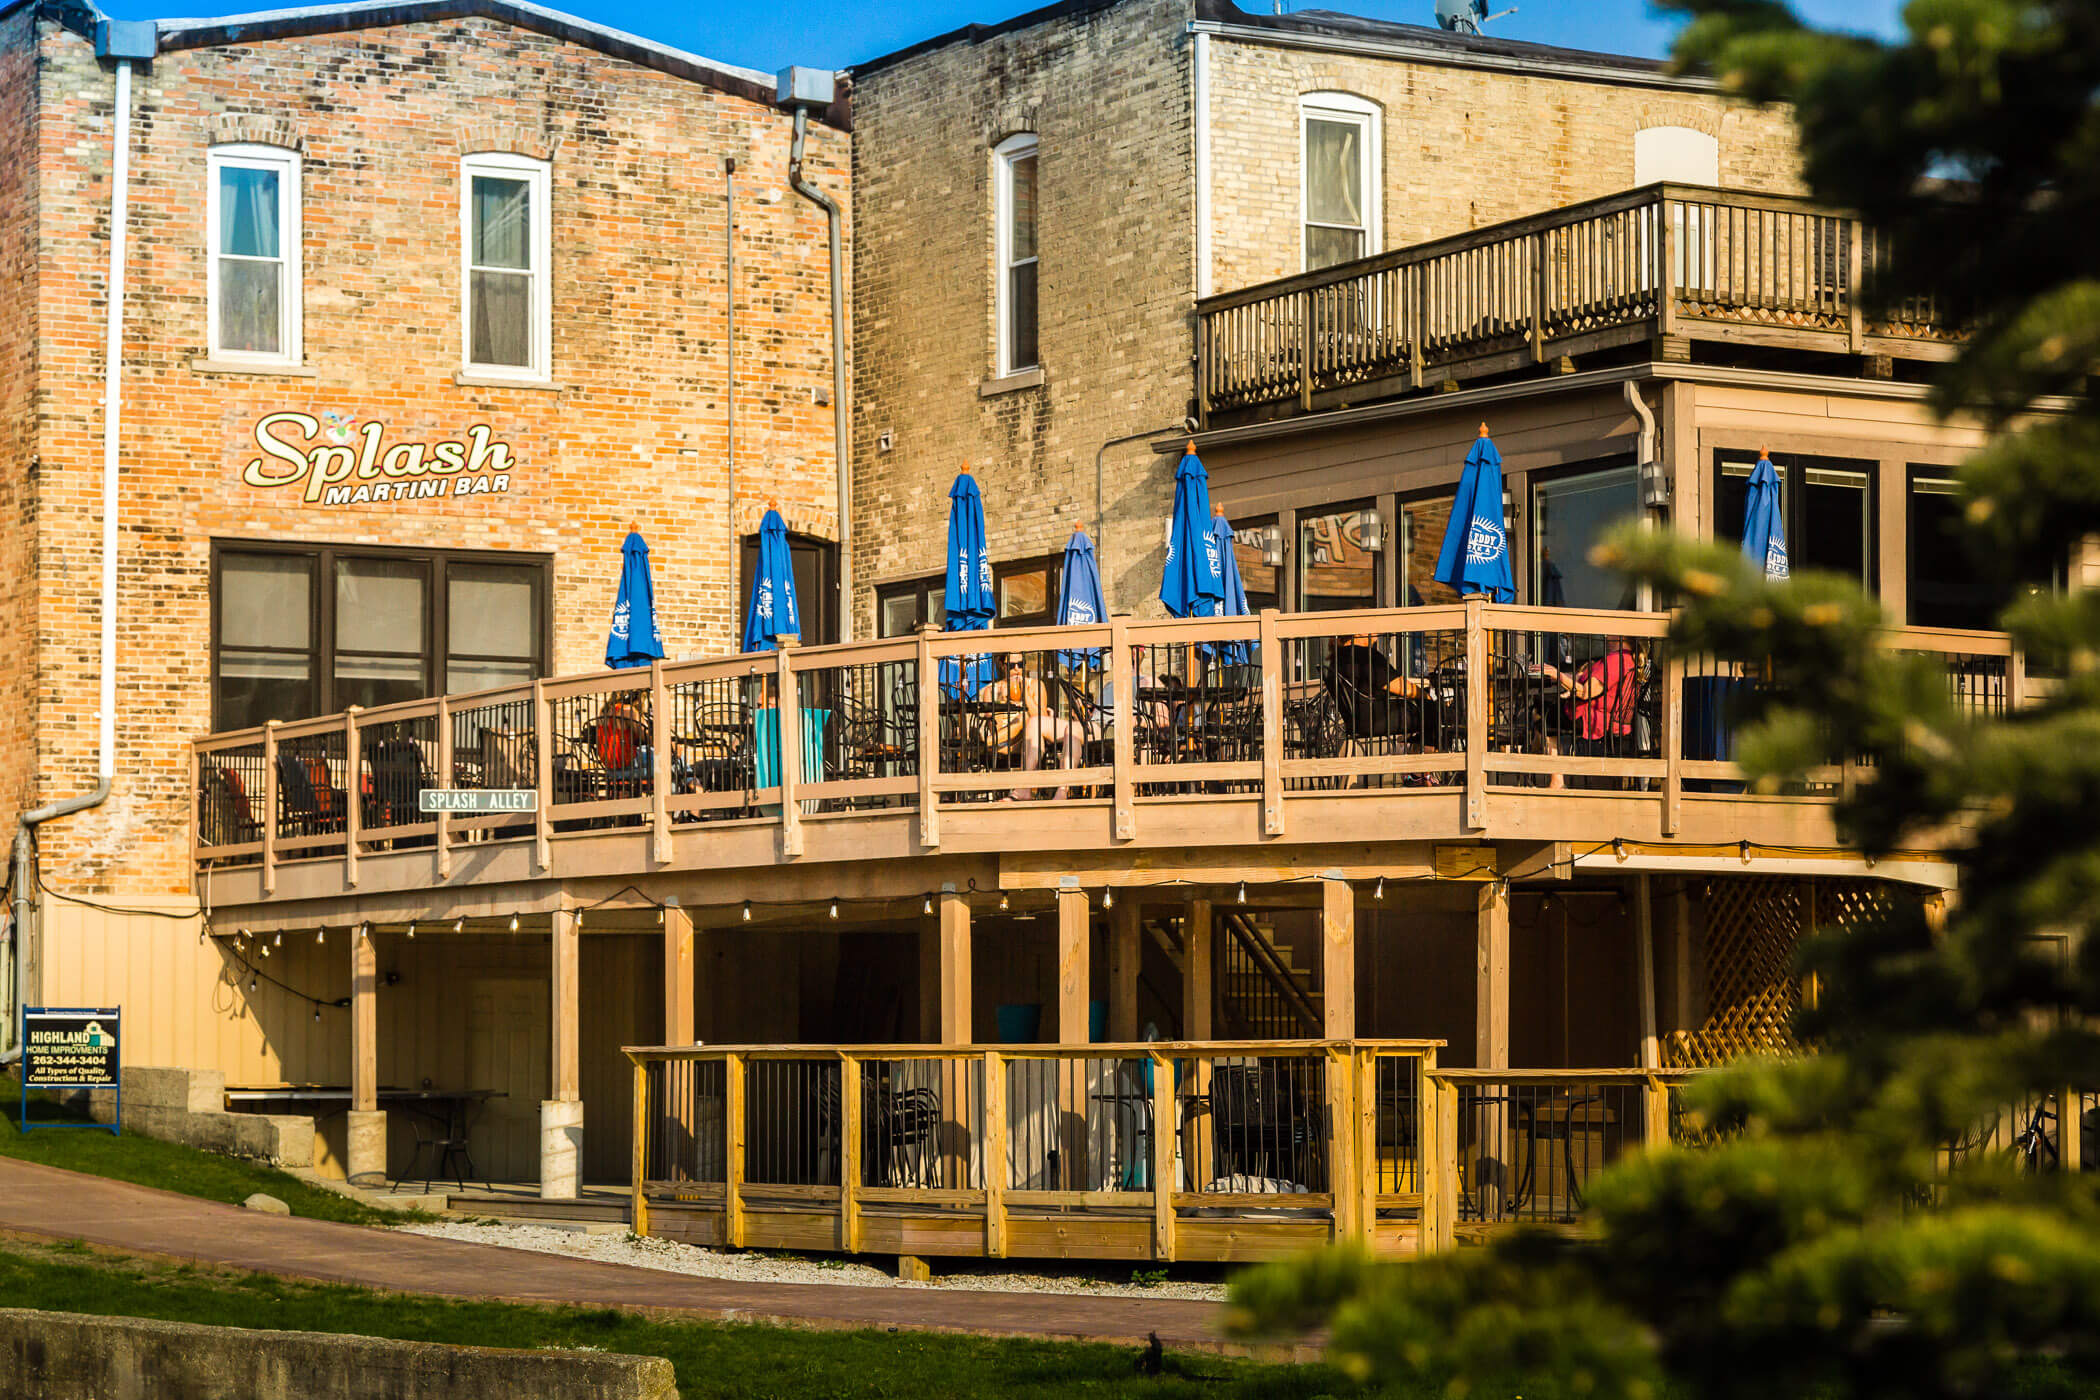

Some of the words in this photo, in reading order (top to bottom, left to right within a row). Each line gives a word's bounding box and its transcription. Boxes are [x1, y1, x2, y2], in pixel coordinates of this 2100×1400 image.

[243, 411, 516, 503] Splash
[324, 478, 448, 506] MARTINI
[453, 474, 510, 496] BAR
[429, 792, 477, 809] SPLASH
[489, 792, 528, 809] ALLEY
[31, 1031, 90, 1044] HIGHLAND
[26, 1046, 49, 1055] HOME
[47, 1067, 67, 1076] Types
[68, 1067, 78, 1075] of
[78, 1067, 106, 1076] Quality
[87, 1075, 112, 1084] Repair
